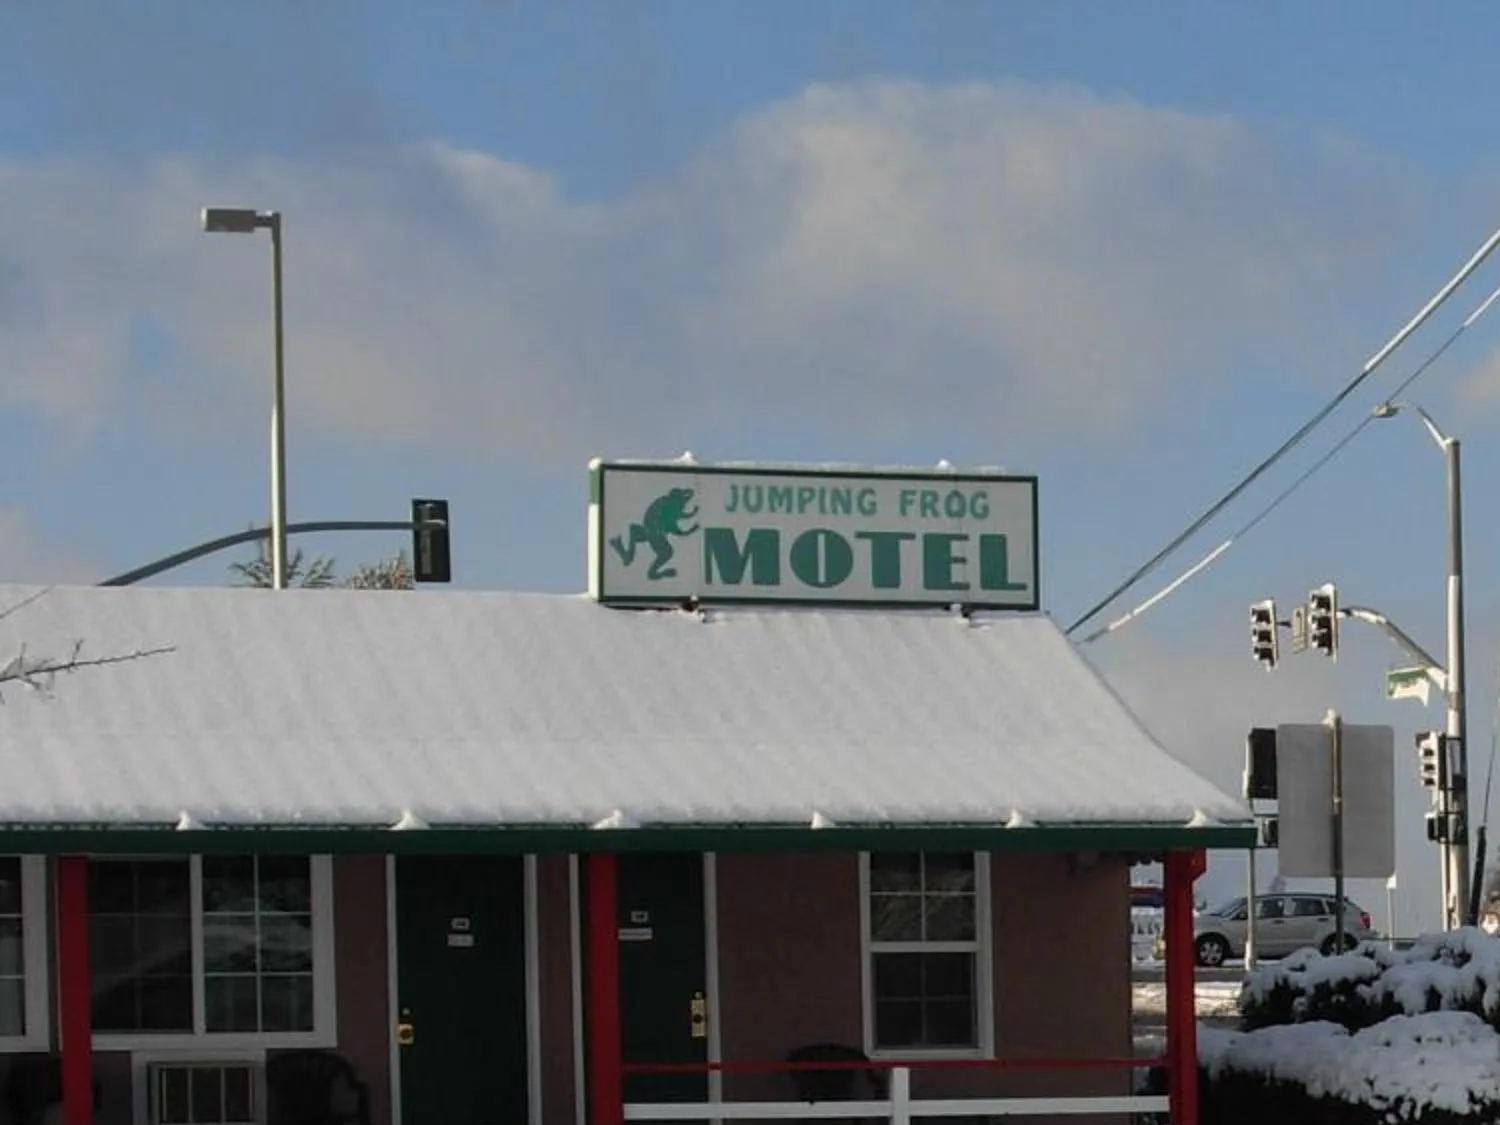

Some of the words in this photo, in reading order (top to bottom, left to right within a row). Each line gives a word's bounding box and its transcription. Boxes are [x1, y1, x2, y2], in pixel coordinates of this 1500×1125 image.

[724, 483, 878, 519] JUMPING
[899, 489, 991, 520] FROG
[703, 526, 1028, 592] MOTEL
